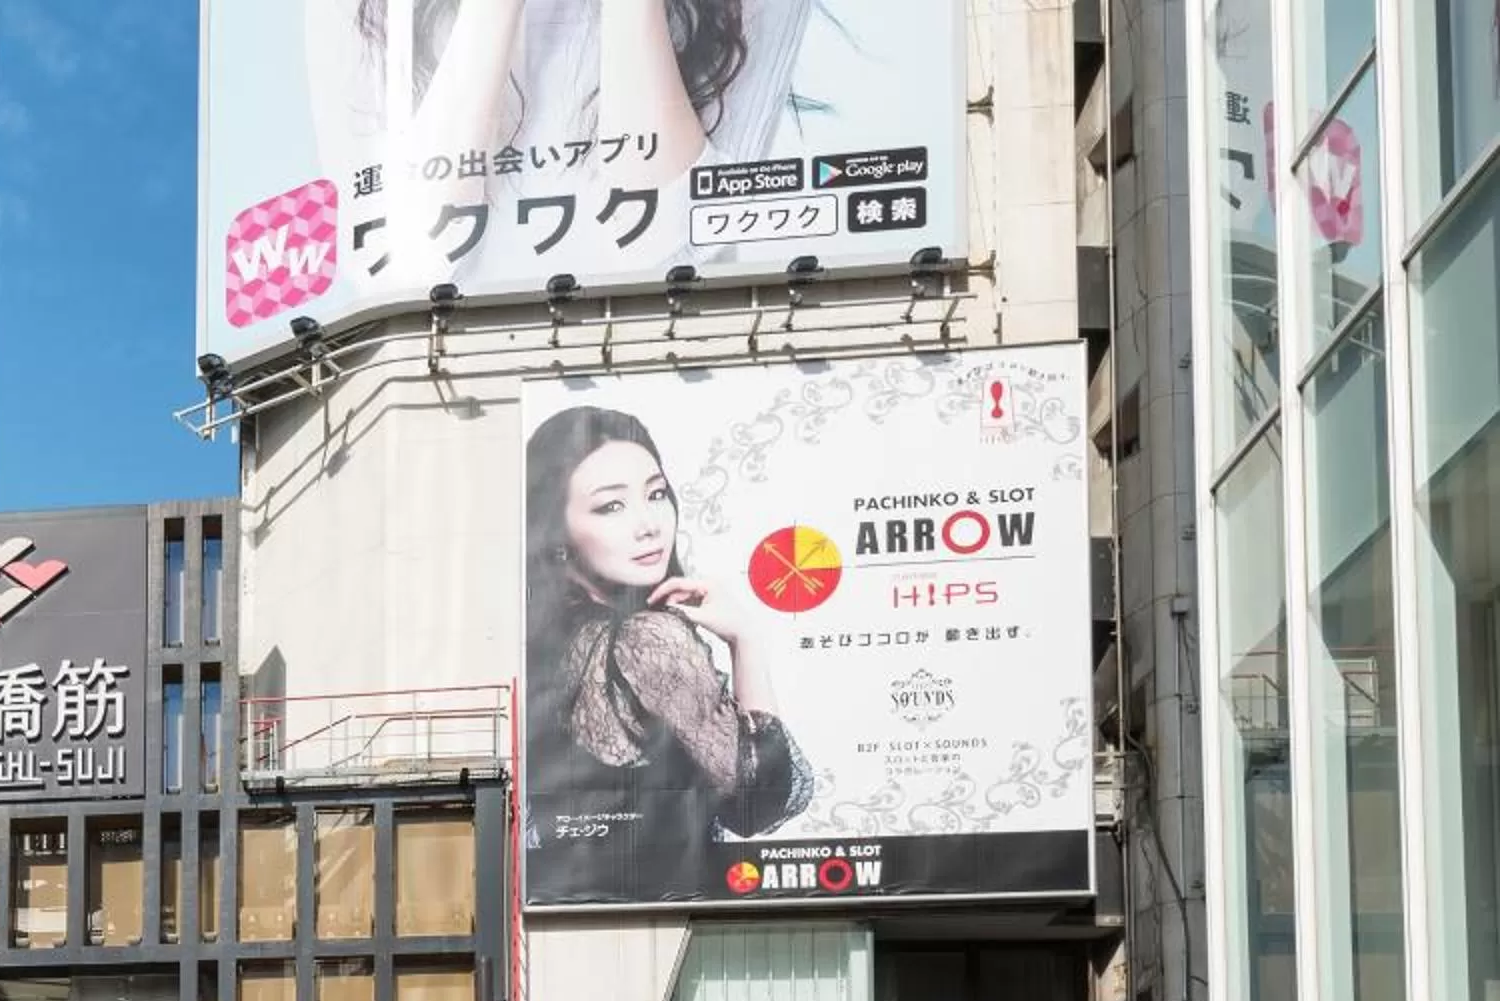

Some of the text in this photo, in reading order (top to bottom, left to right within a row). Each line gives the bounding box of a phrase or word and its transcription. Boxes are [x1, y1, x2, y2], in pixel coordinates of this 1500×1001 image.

[353, 132, 660, 198] 運の出会いアプリ
[845, 163, 892, 180] Google
[898, 158, 923, 175] play
[717, 173, 797, 194] App Store
[353, 187, 659, 276] ワクワク
[707, 205, 820, 235] ワクワク
[854, 487, 1035, 511] PACHINKO & SLOT
[856, 510, 1035, 555] ARROW
[761, 846, 881, 859] PACHINKO & SLOT
[761, 858, 882, 892] ARROW
